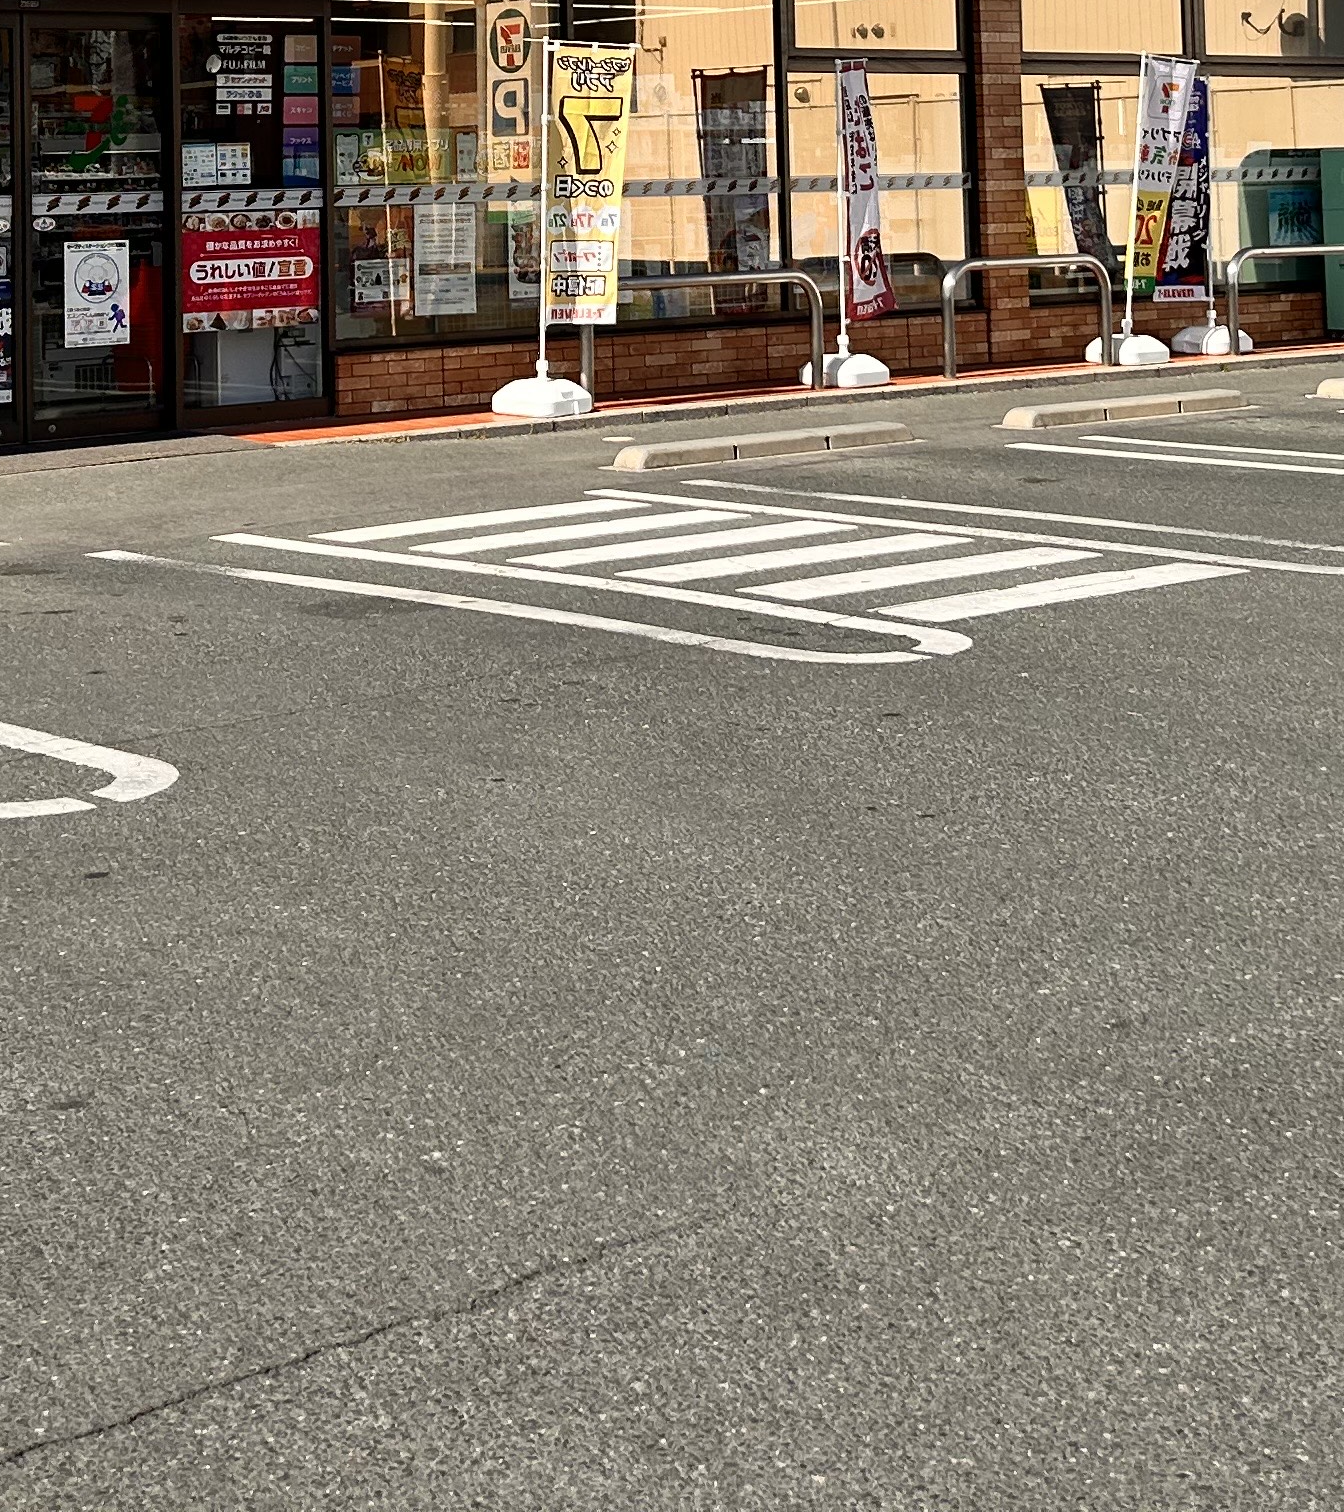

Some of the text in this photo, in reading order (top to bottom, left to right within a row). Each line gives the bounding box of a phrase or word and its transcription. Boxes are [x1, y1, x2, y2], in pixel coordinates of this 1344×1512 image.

[291, 76, 313, 84] プリント
[290, 106, 313, 114] スキャン
